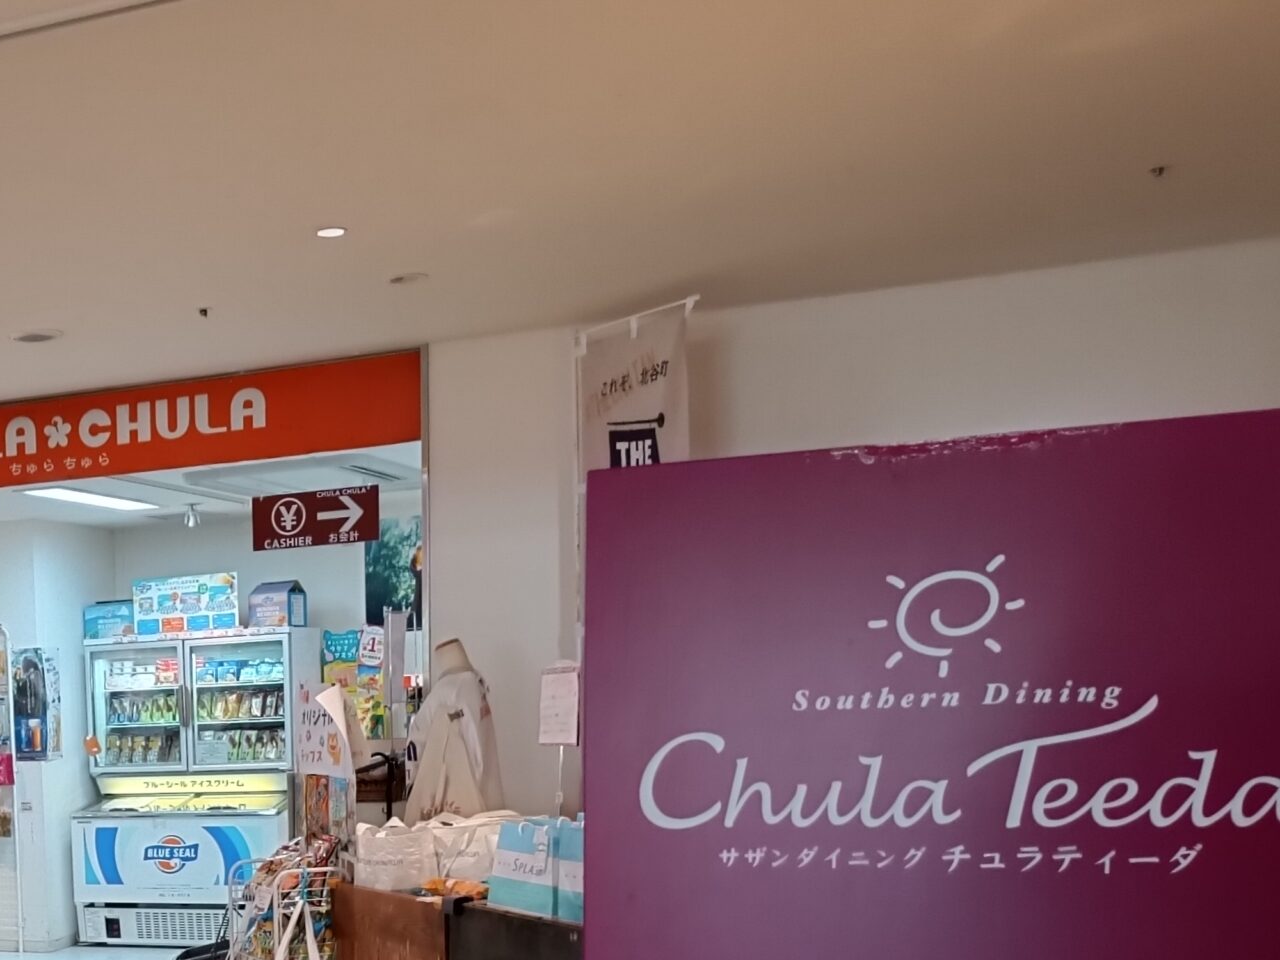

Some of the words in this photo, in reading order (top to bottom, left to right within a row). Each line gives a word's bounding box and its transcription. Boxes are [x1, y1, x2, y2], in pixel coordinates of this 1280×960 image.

[78, 387, 267, 448] CHULA
[8, 458, 56, 476] ちゅら
[62, 452, 111, 471] ちゅら
[615, 438, 653, 469] THE
[316, 489, 341, 498] CHULA
[341, 486, 367, 495] CHULA
[264, 535, 313, 550] CASHIER
[328, 530, 360, 543] お会計
[791, 689, 961, 712] Southern
[981, 682, 1123, 710] Dining
[638, 731, 962, 830] Chula
[967, 694, 1280, 830] Teeda
[190, 779, 245, 788] アイスクリーム
[147, 848, 171, 858] BLUE
[172, 848, 197, 858] SEAL
[718, 846, 929, 870] サザンダイニング
[941, 842, 1204, 874] チュラティーダ
